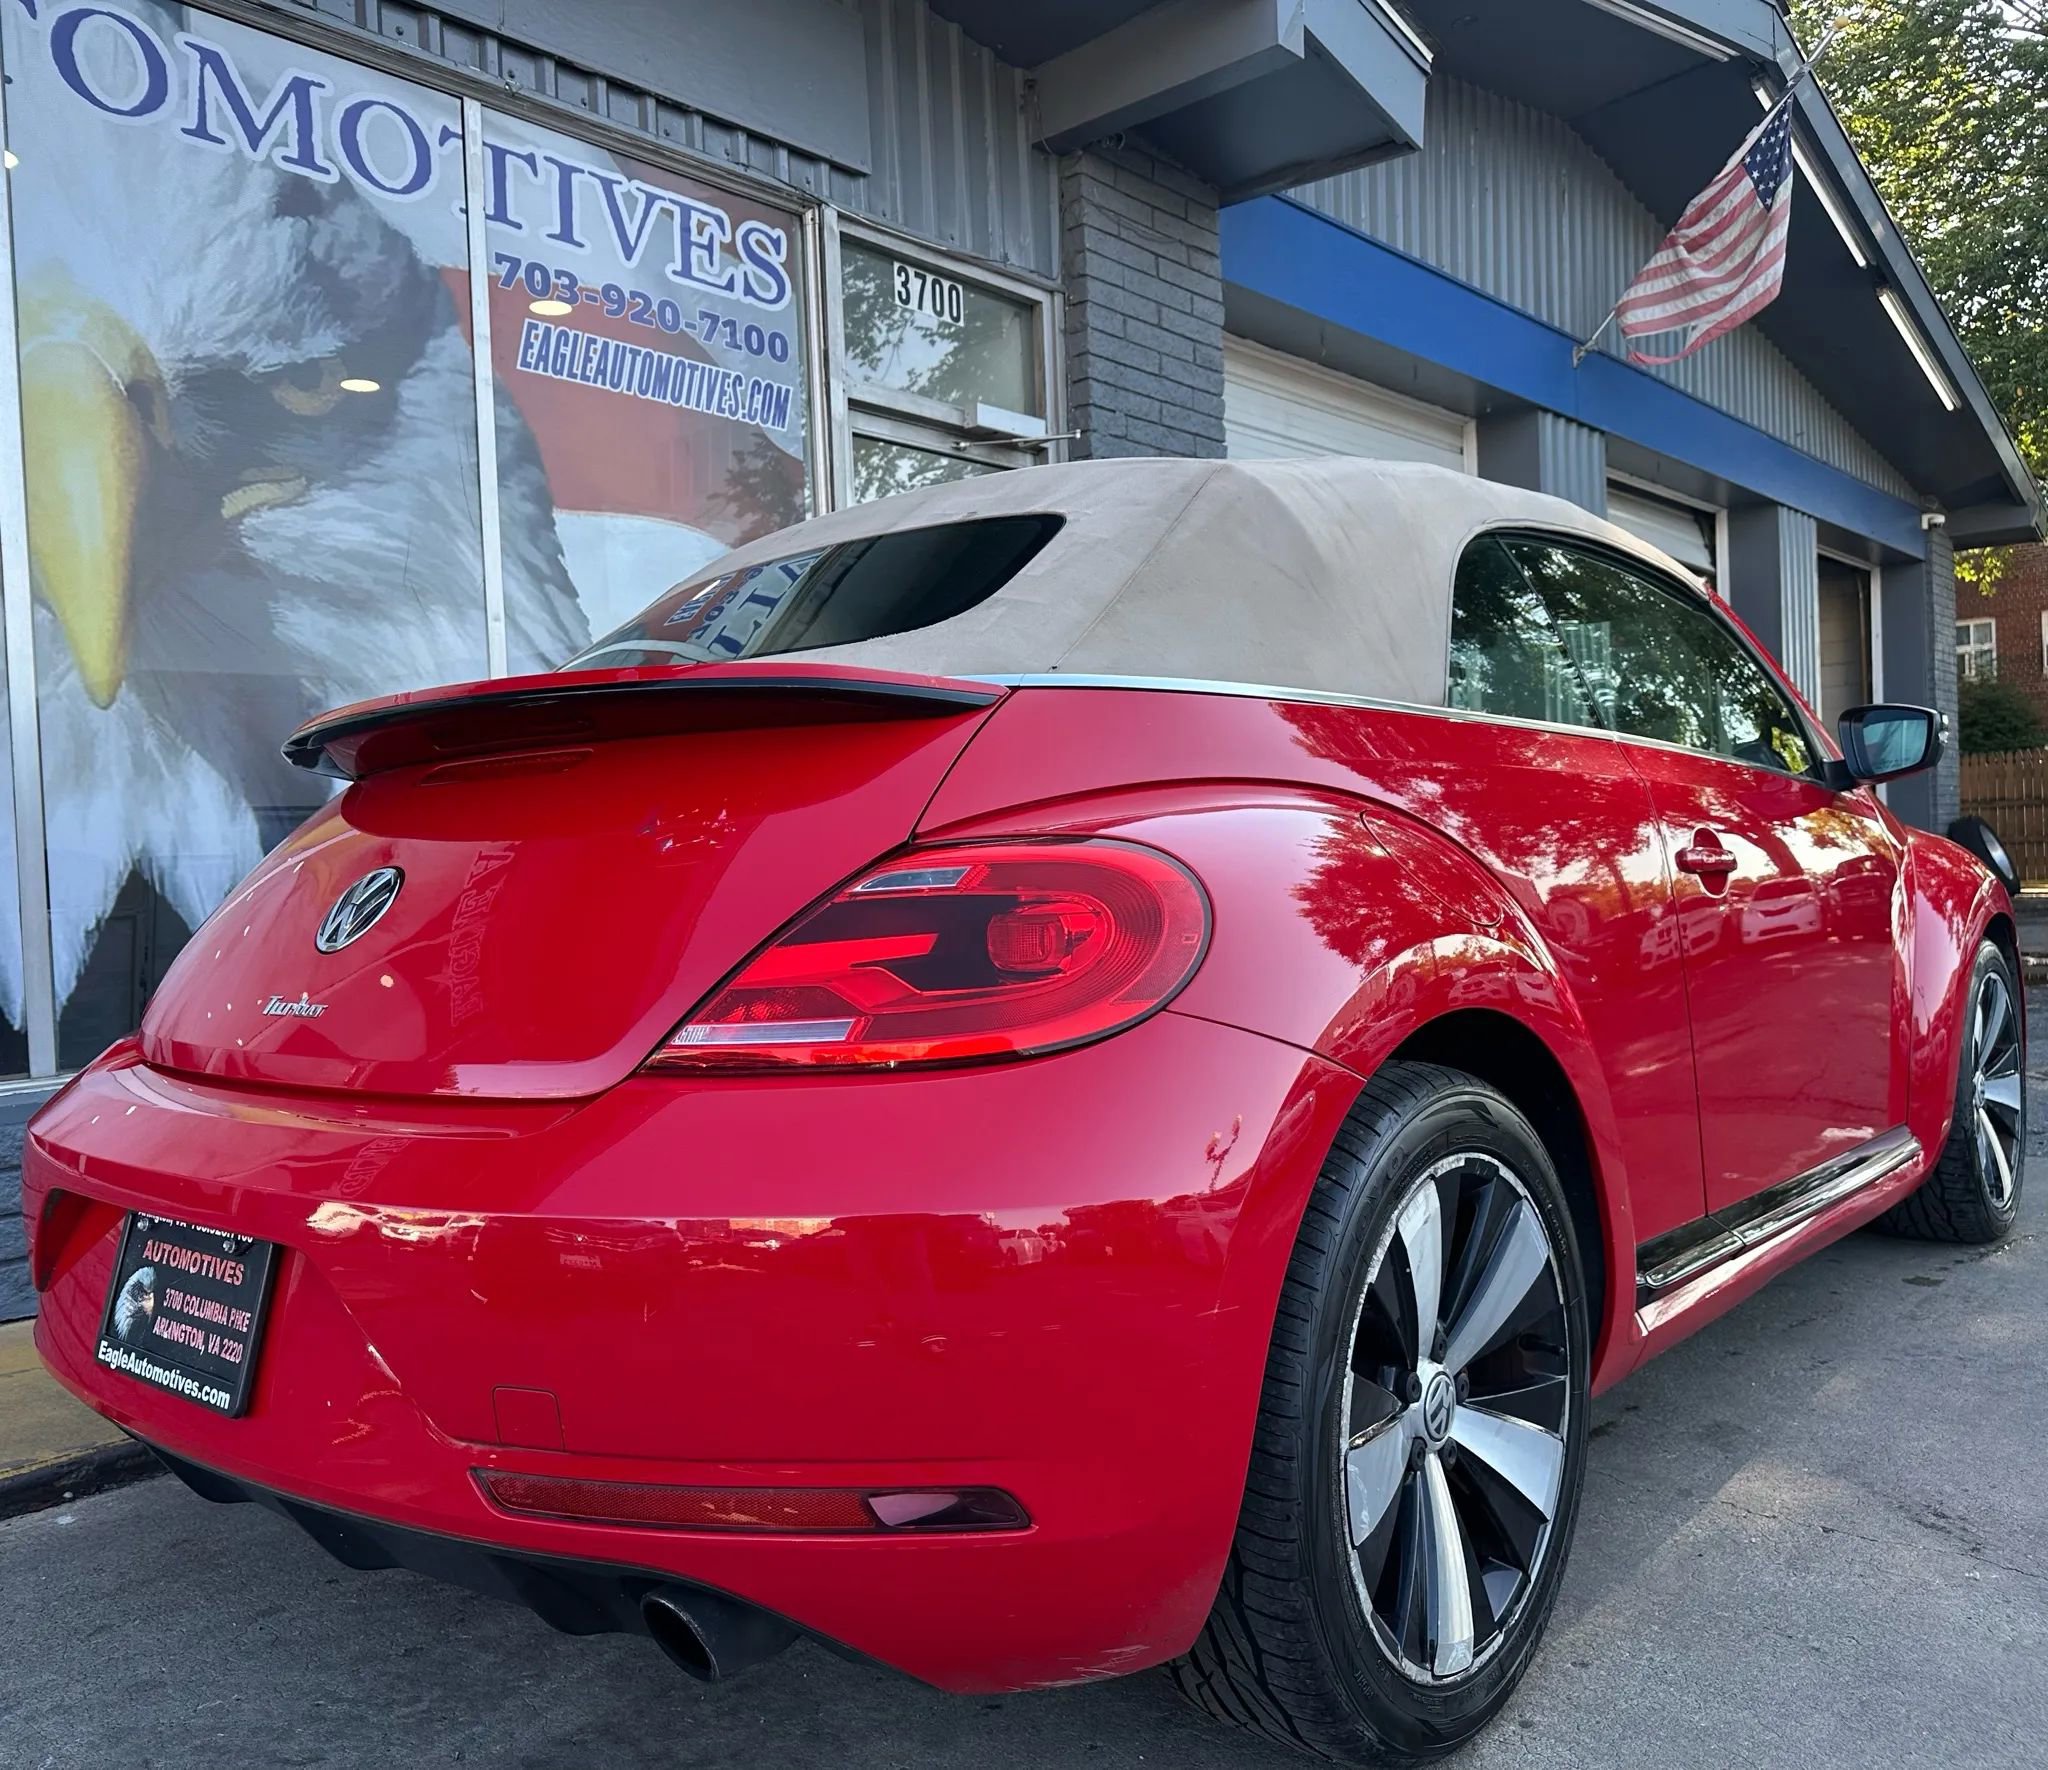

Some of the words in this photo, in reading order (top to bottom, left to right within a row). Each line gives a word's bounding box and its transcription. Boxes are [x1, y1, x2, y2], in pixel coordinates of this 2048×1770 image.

[17, 0, 789, 305] OMOTIVES
[494, 251, 790, 363] 703-920-7100
[897, 265, 961, 323] 3700
[517, 319, 793, 431] EAGLEAUTOMOTIVES.COM
[142, 1240, 245, 1285] AUTOMOTIVES
[152, 1316, 205, 1355] ARLINGTON,
[207, 1333, 220, 1355] VA
[164, 1288, 183, 1310] 3700
[183, 1294, 228, 1325] COLUMBIA
[228, 1307, 251, 1332] PIKE
[98, 1340, 230, 1409] EagleAutomotives.com
